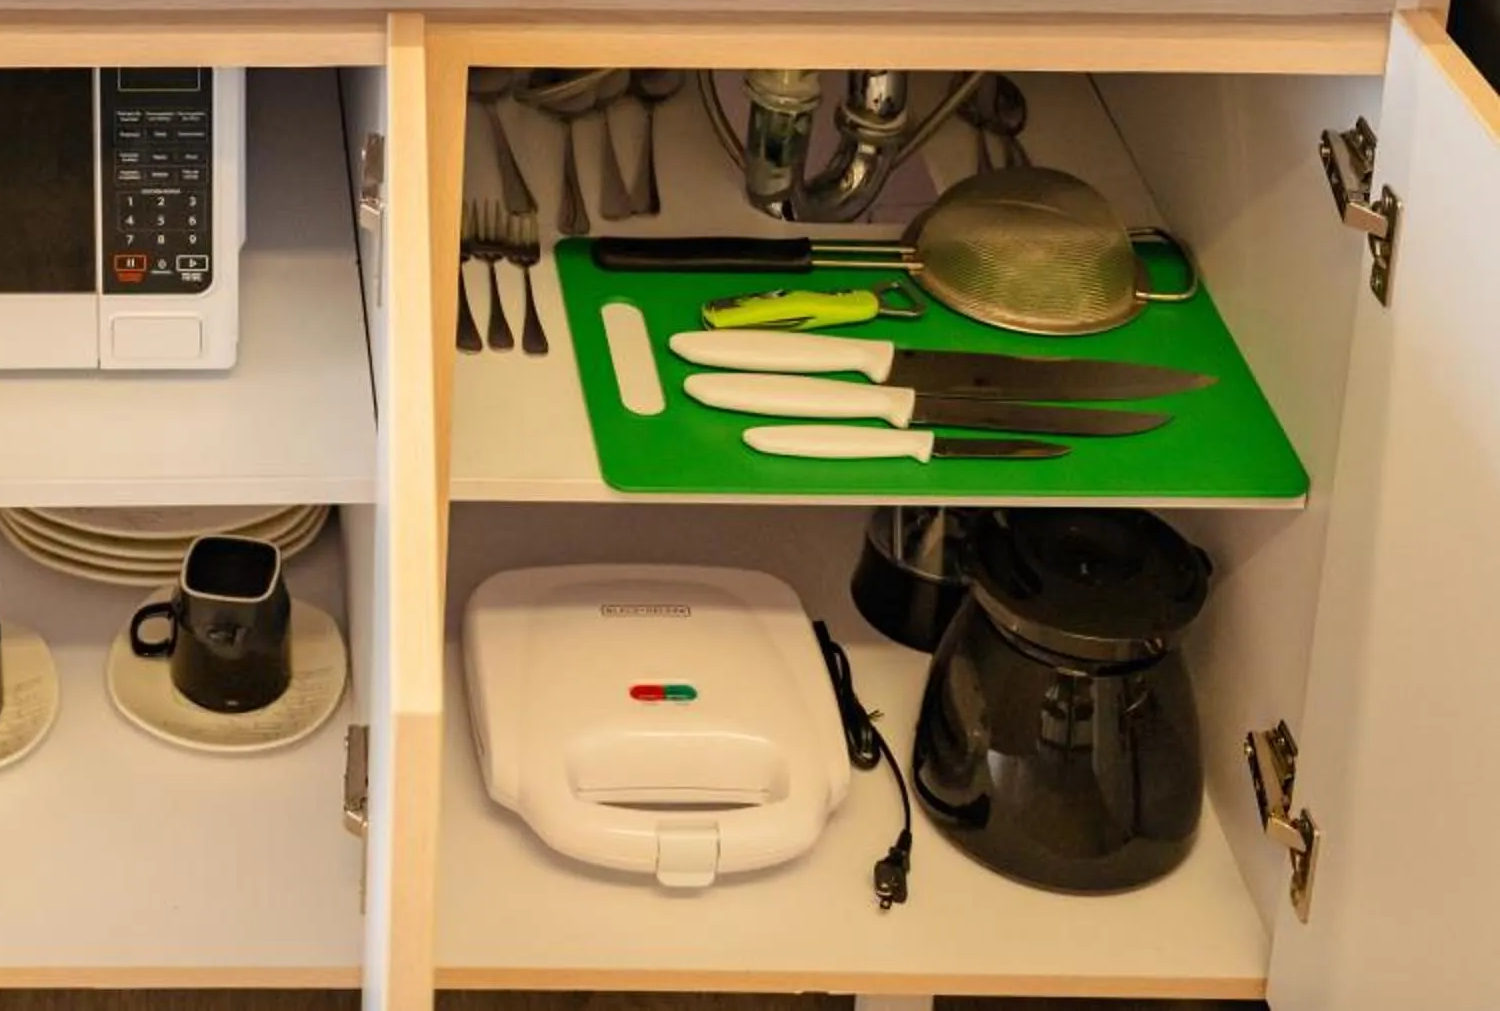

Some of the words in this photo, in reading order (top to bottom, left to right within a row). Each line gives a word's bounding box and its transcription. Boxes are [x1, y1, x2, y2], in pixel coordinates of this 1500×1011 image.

[157, 196, 165, 206] 2
[188, 196, 197, 207] 3
[125, 215, 134, 226] 4
[157, 215, 165, 226] 5
[188, 215, 197, 226] 6
[126, 234, 134, 246] 7
[188, 234, 197, 245] 9
